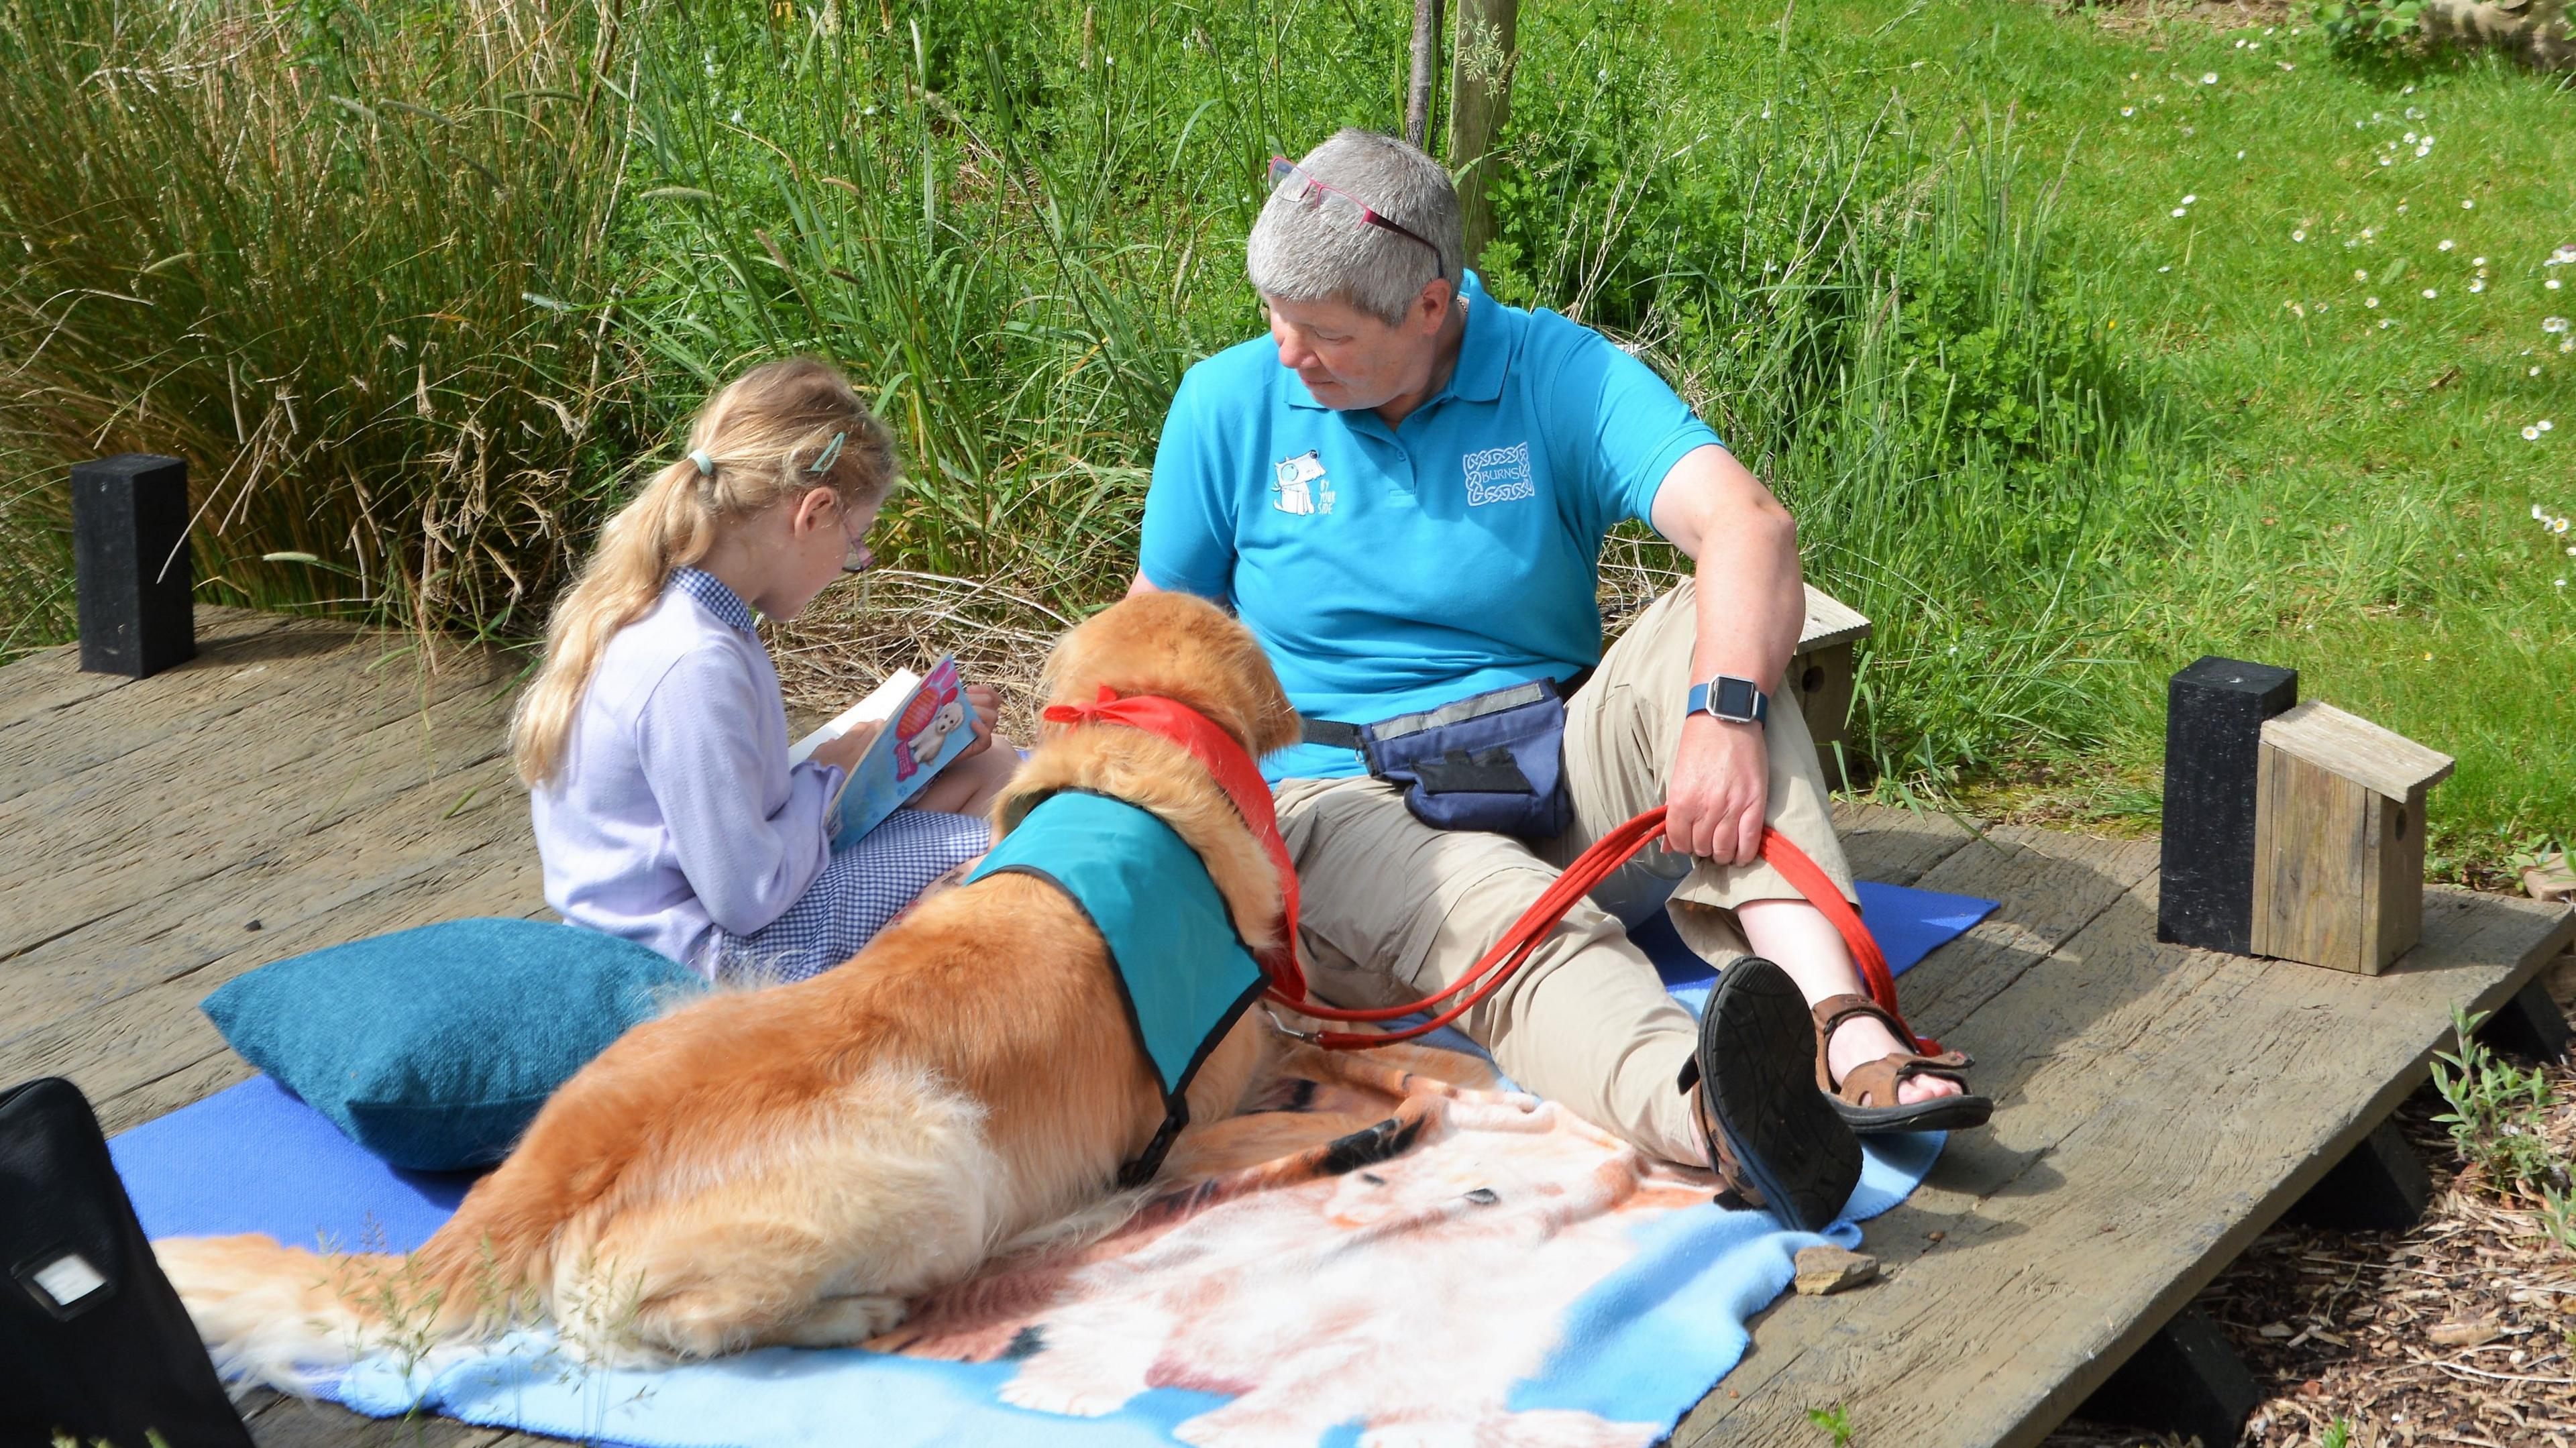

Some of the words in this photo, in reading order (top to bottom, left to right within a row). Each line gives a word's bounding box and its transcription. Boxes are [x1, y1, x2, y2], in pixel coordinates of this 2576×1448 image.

[1481, 467, 1519, 483] BURNS
[1320, 479, 1330, 492] BY
[1320, 491, 1336, 504] YOUR
[1318, 503, 1332, 515] SIDE
